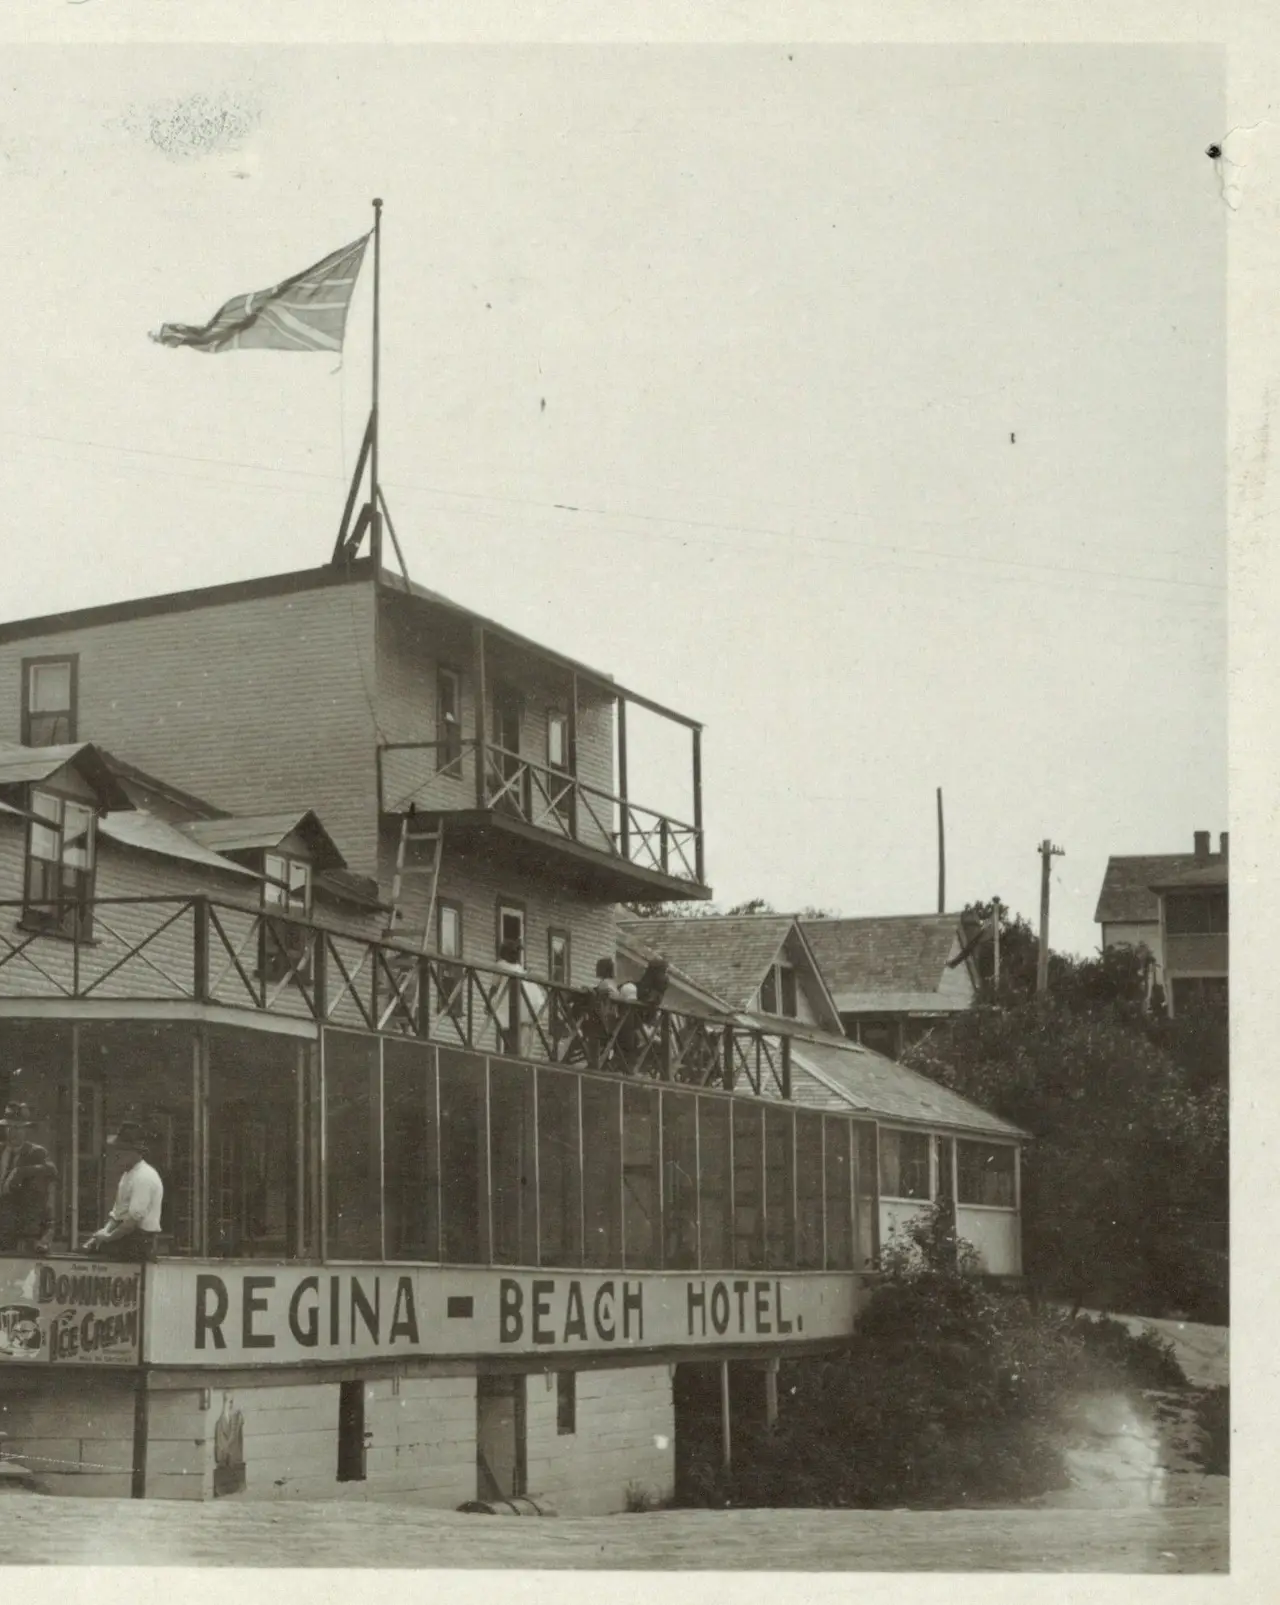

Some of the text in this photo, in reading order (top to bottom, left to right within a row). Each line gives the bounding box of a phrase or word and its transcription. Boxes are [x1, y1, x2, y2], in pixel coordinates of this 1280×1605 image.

[49, 1309, 139, 1361] ICE CREAM
[194, 1274, 420, 1350] REGINA
[499, 1278, 643, 1344] BEACH
